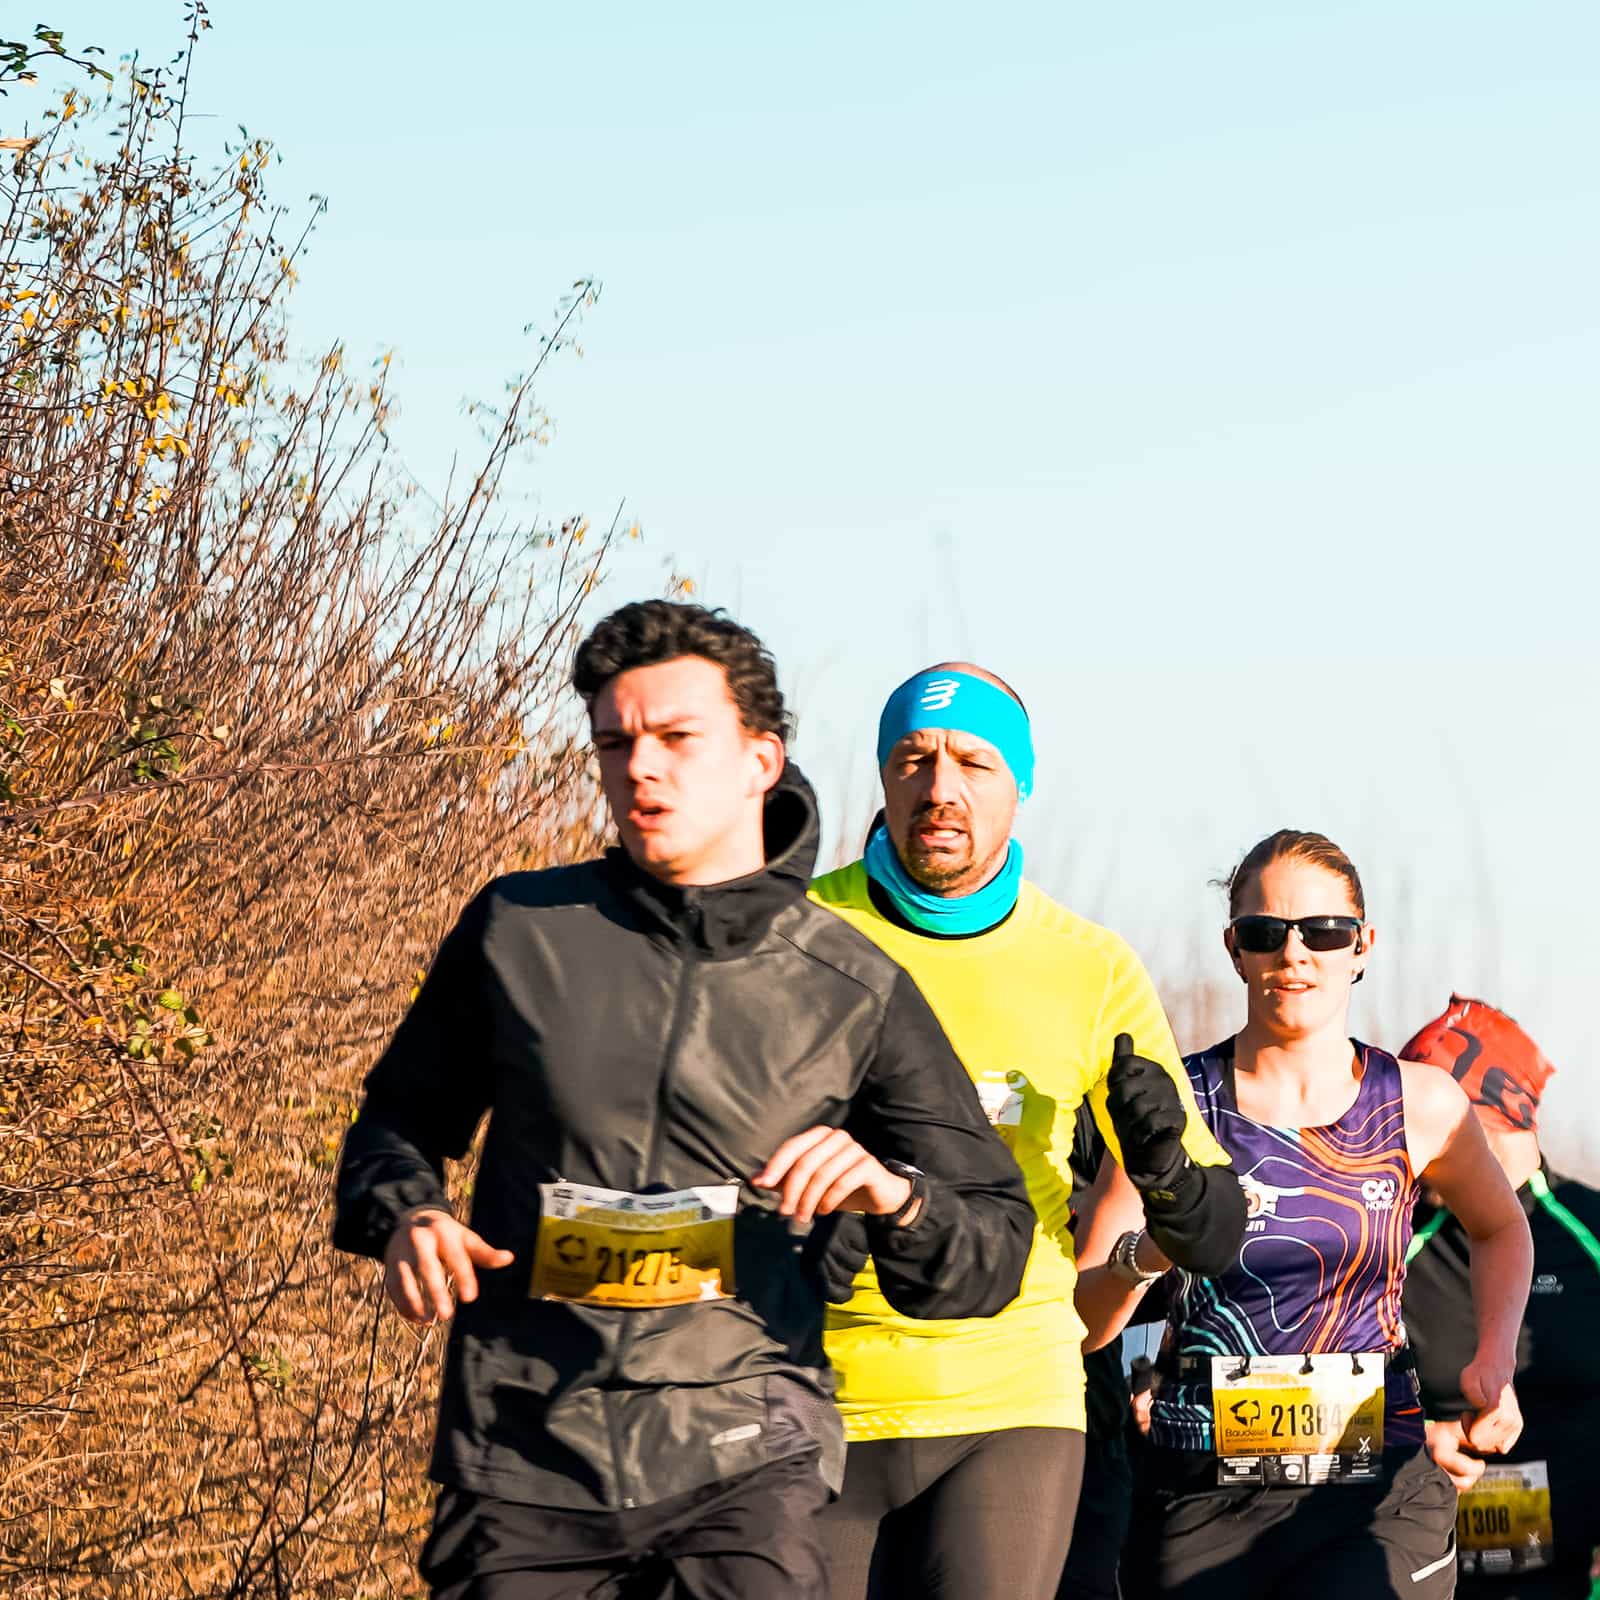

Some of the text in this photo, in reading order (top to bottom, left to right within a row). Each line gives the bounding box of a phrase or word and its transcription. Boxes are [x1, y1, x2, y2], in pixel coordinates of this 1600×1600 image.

[1245, 1219, 1266, 1232] un
[597, 1246, 682, 1286] 21275
[1456, 1504, 1510, 1537] 1308
